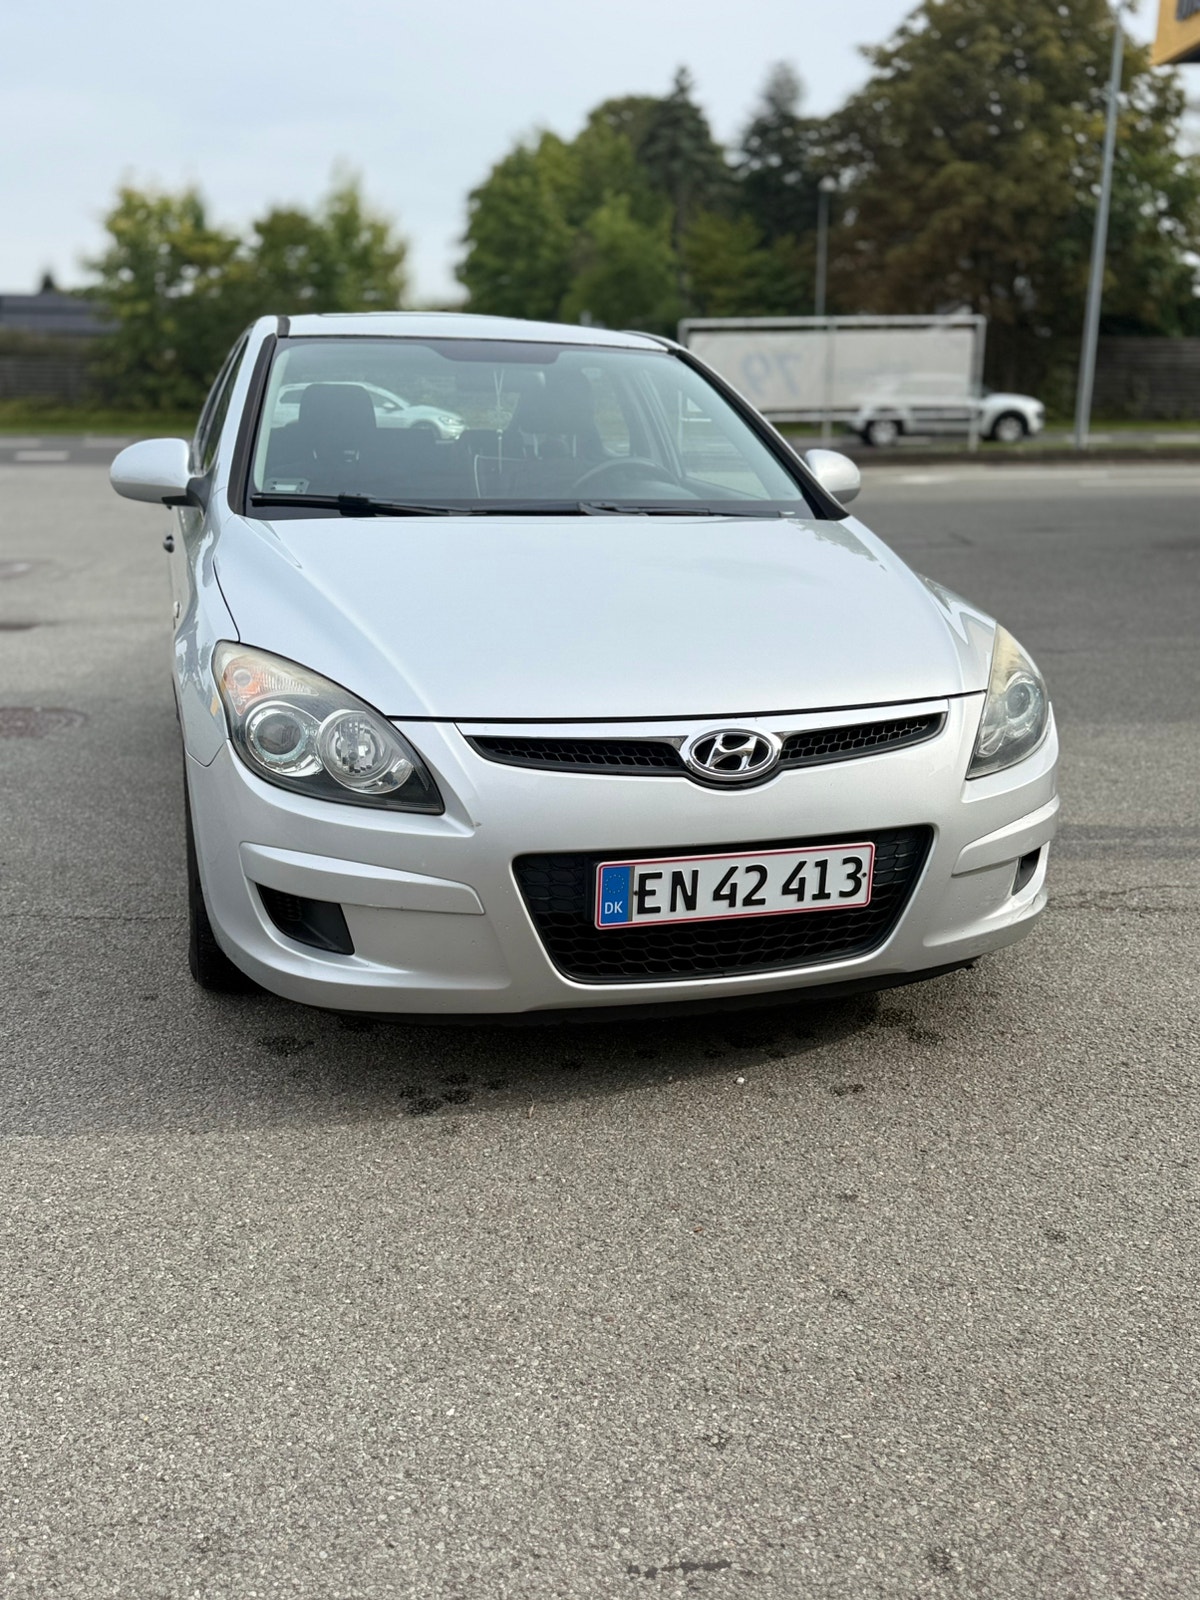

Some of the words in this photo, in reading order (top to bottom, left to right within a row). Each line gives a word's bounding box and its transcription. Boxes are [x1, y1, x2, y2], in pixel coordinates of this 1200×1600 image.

[636, 869, 699, 915] EN
[712, 865, 768, 908] 42
[781, 856, 863, 902] 413
[604, 900, 623, 915] DK
